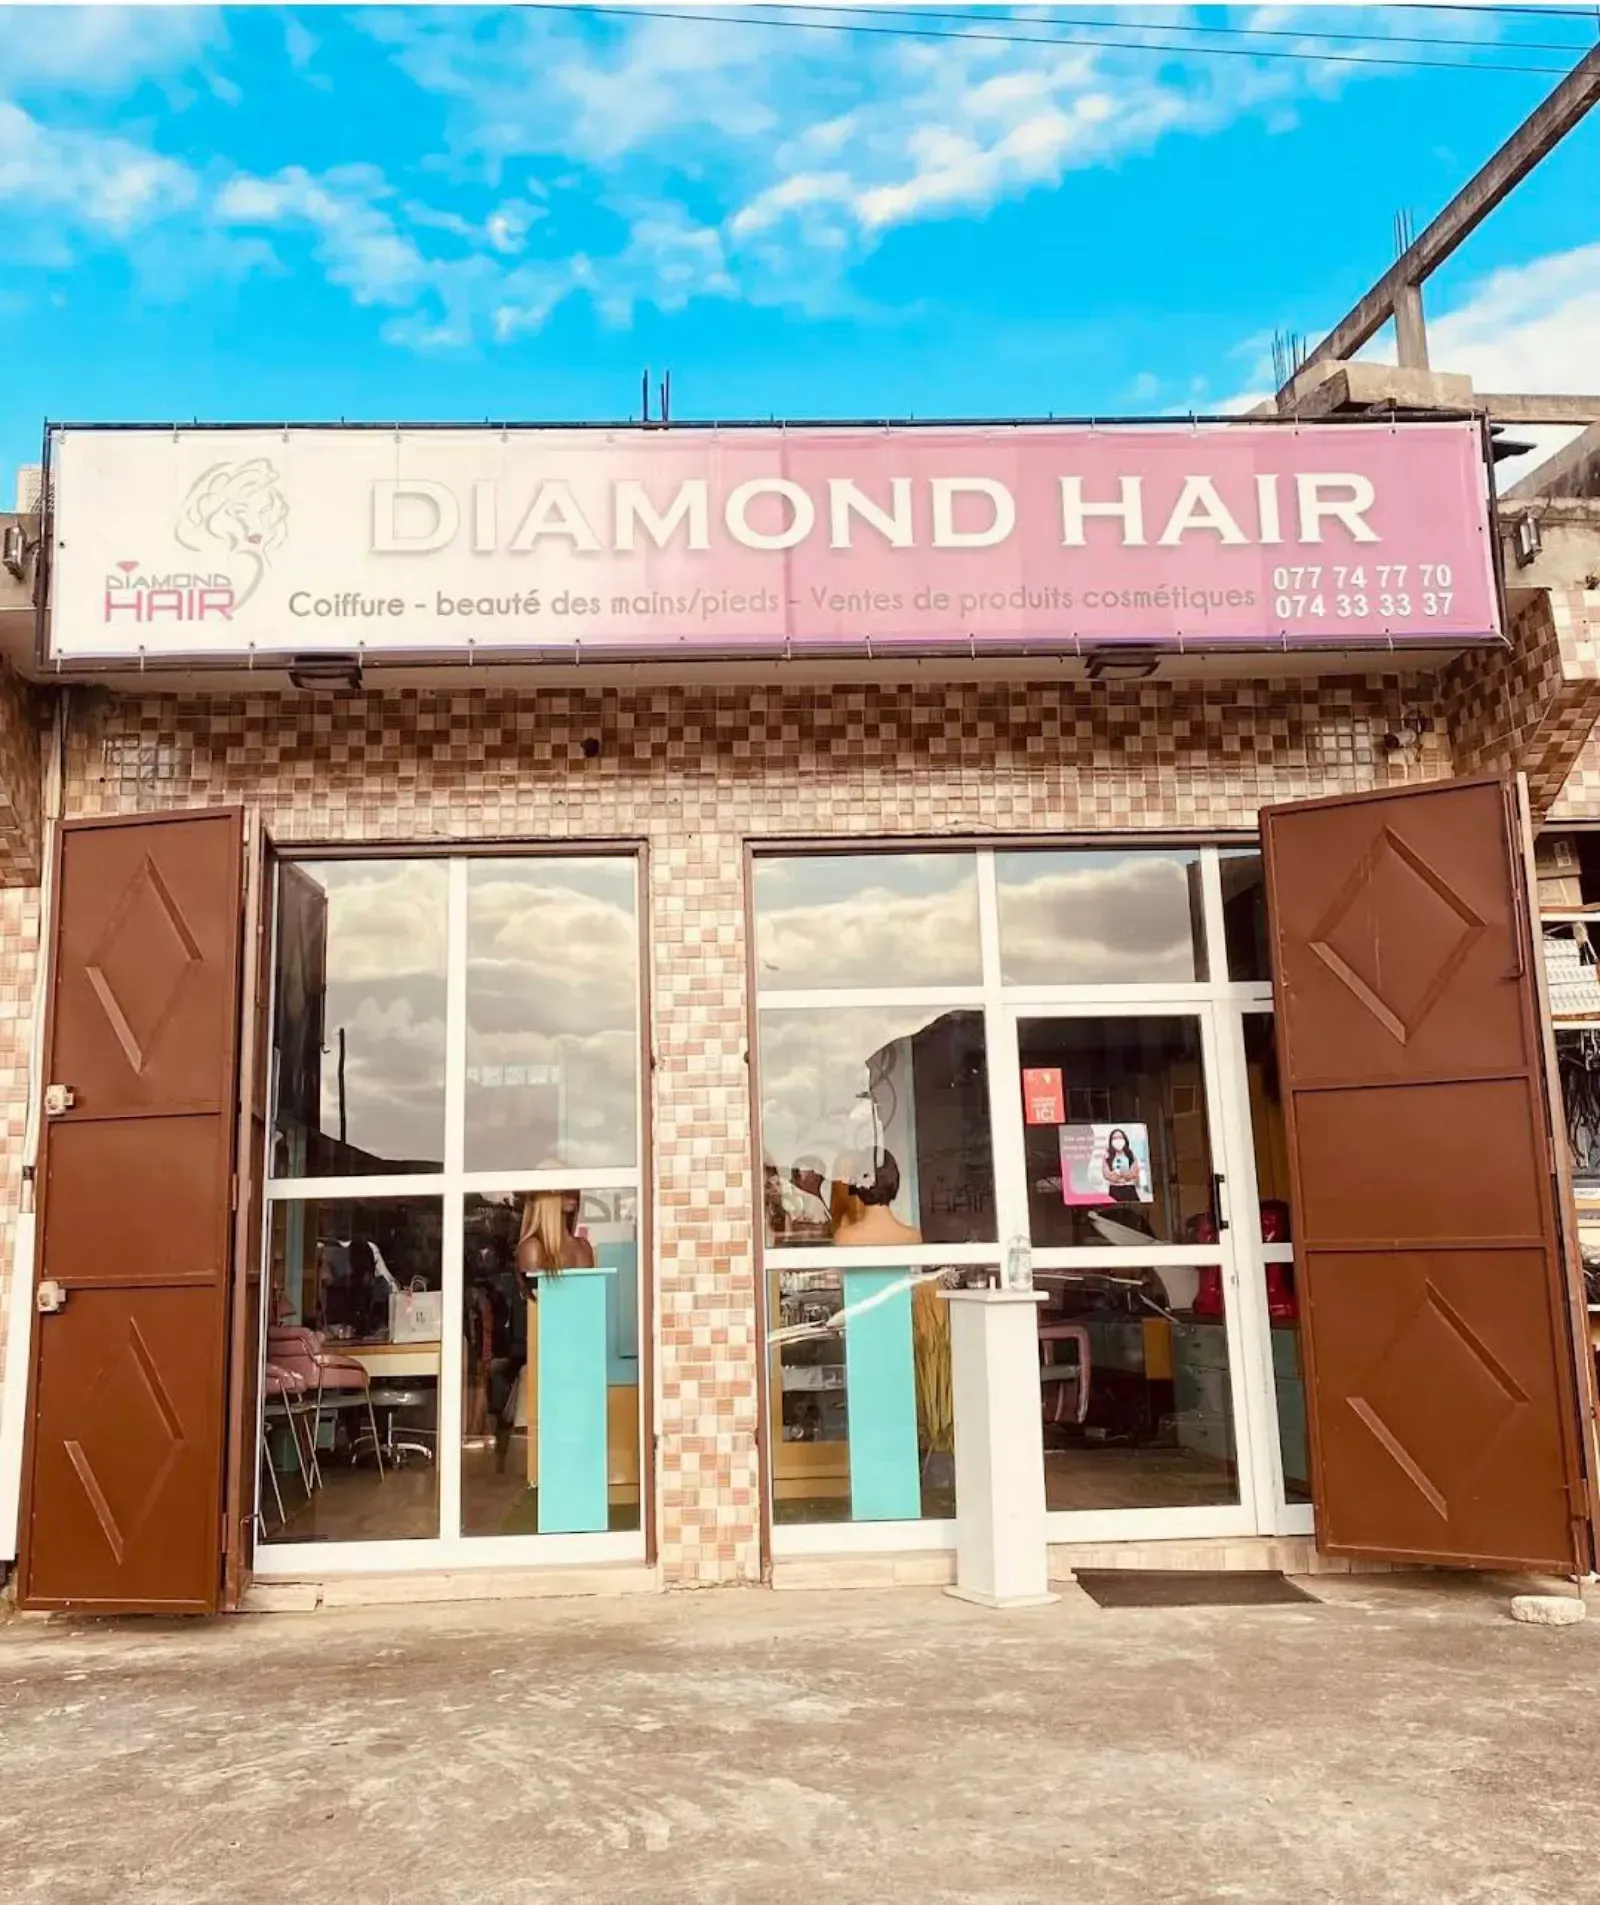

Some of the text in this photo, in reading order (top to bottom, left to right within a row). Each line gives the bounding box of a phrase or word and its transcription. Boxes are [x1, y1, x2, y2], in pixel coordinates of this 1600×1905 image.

[370, 472, 1384, 552] DIAMOND HAIR
[105, 573, 232, 590] DIAMOND
[1273, 564, 1452, 591] 077 74 77 70
[104, 588, 235, 623] HAIR
[288, 591, 405, 617] Coiffure
[436, 589, 541, 616] beauté
[550, 589, 601, 616] des
[611, 587, 779, 621] mains/pieds
[810, 586, 903, 612] Ventes
[914, 585, 950, 611] de
[960, 584, 1073, 619] produits
[1083, 583, 1255, 617] cosmétiques
[1275, 592, 1453, 618] 074 33 33 37
